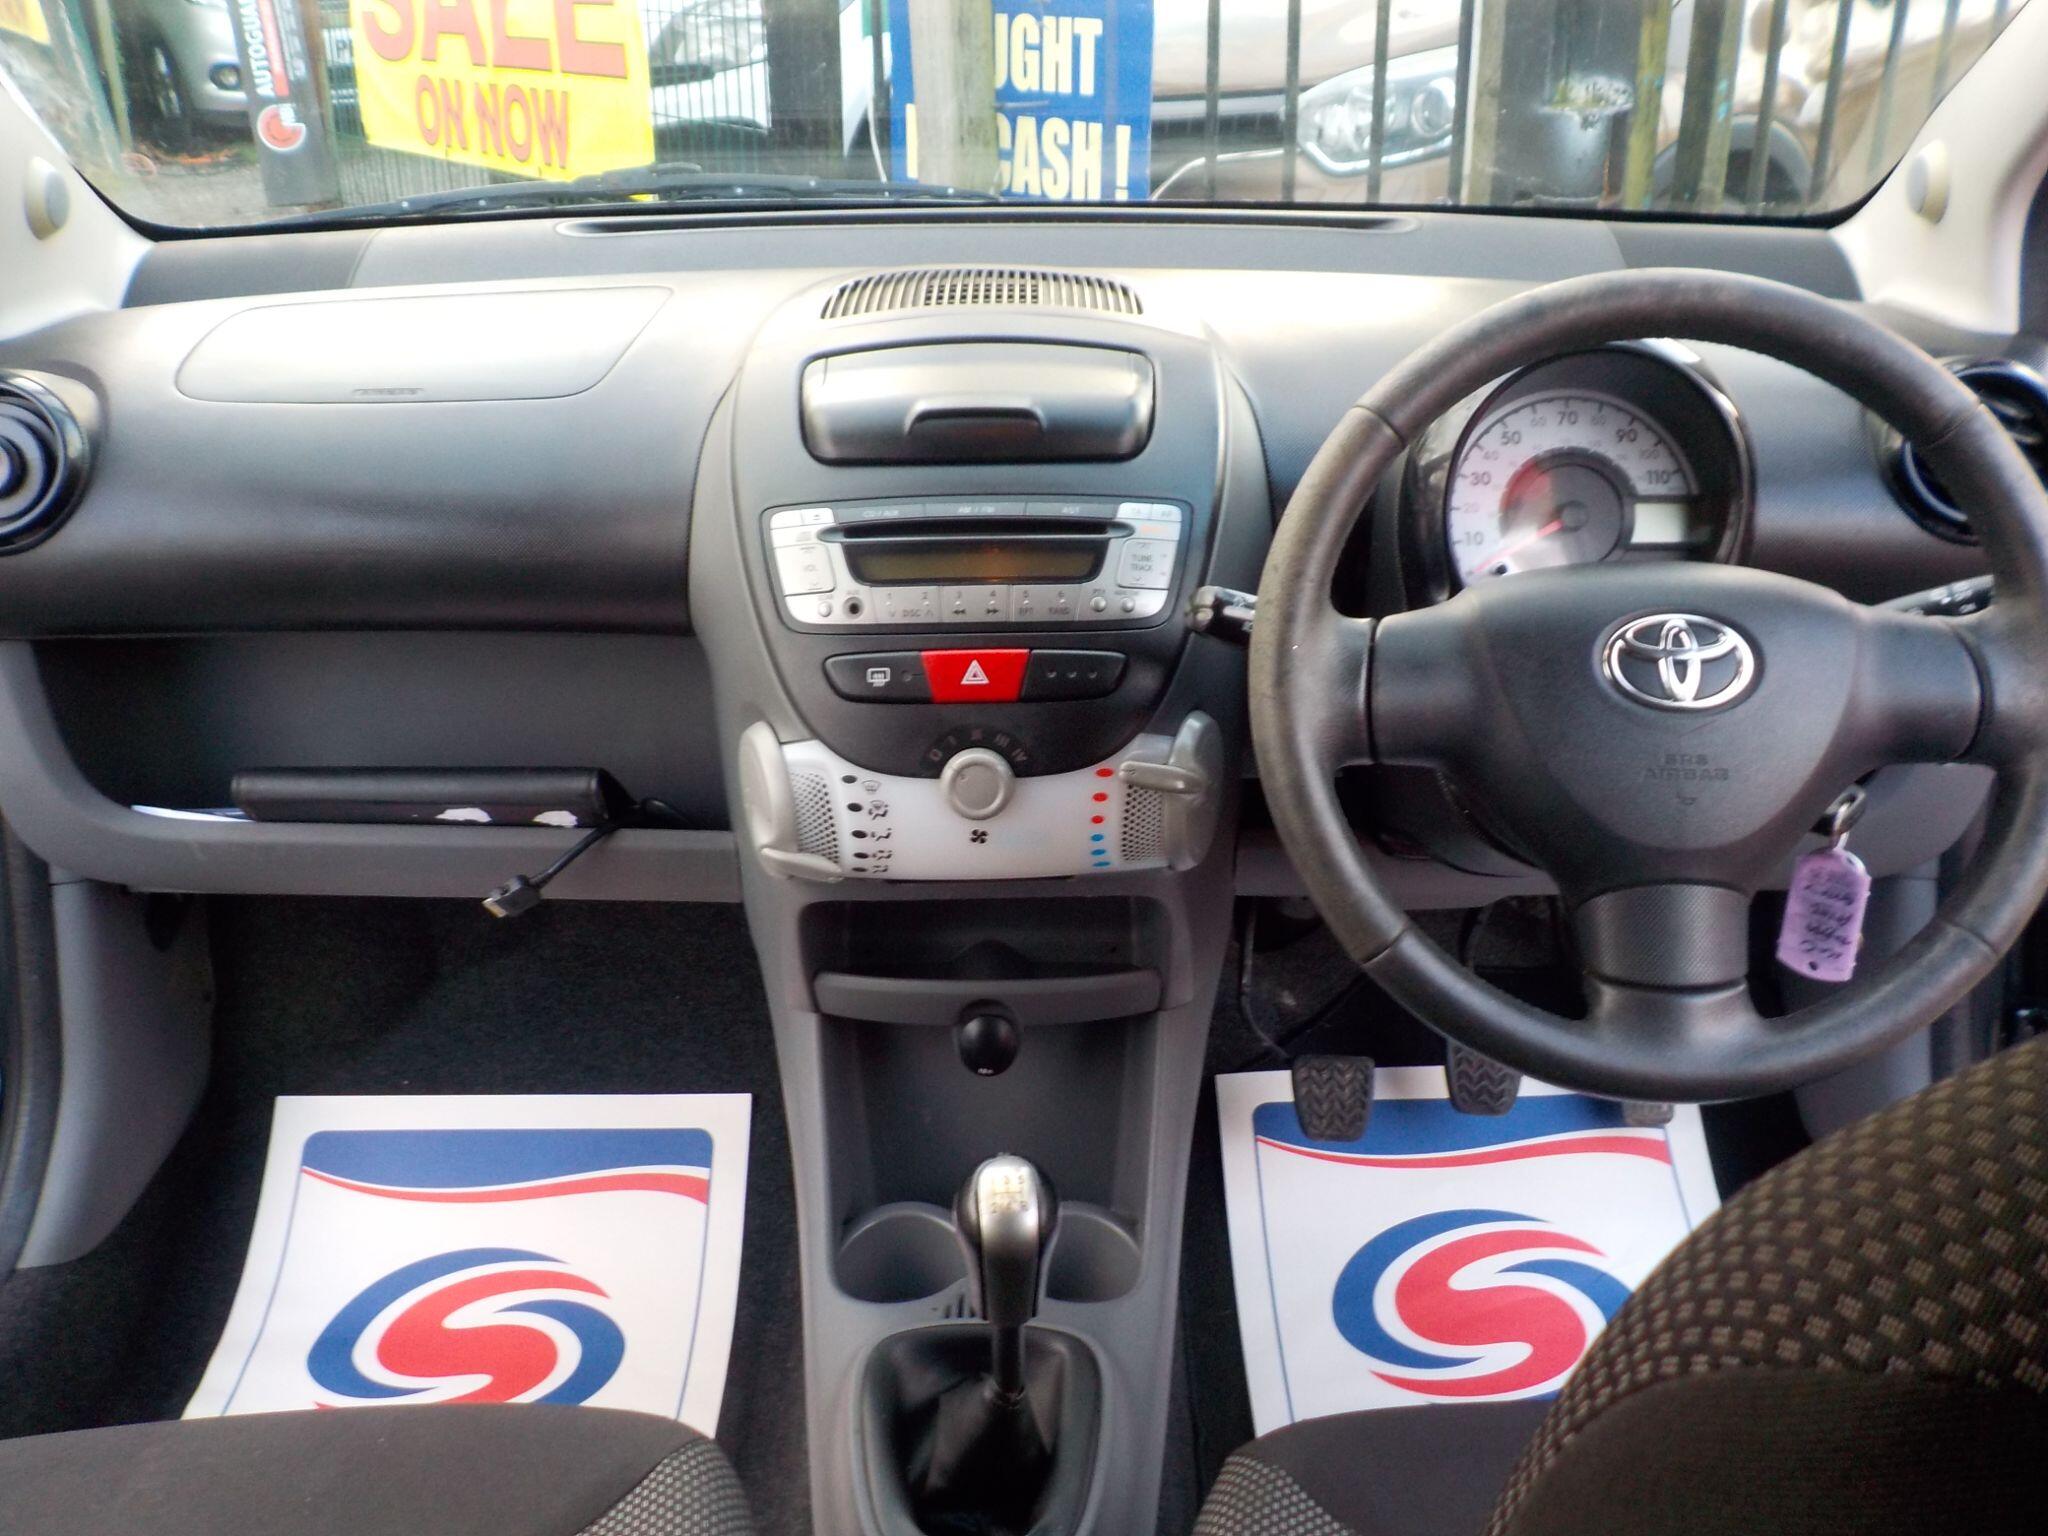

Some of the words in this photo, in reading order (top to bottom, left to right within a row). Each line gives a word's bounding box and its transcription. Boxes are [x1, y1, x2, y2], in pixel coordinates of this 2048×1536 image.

[238, 0, 276, 98] AUTOGUA
[414, 75, 468, 151] ON
[475, 83, 568, 169] NOW
[1557, 410, 1578, 425] 70
[1501, 430, 1521, 446] 50
[1616, 428, 1638, 442] 90
[1469, 471, 1491, 486] 30
[1647, 469, 1671, 485] 110
[1466, 531, 1484, 546] 10
